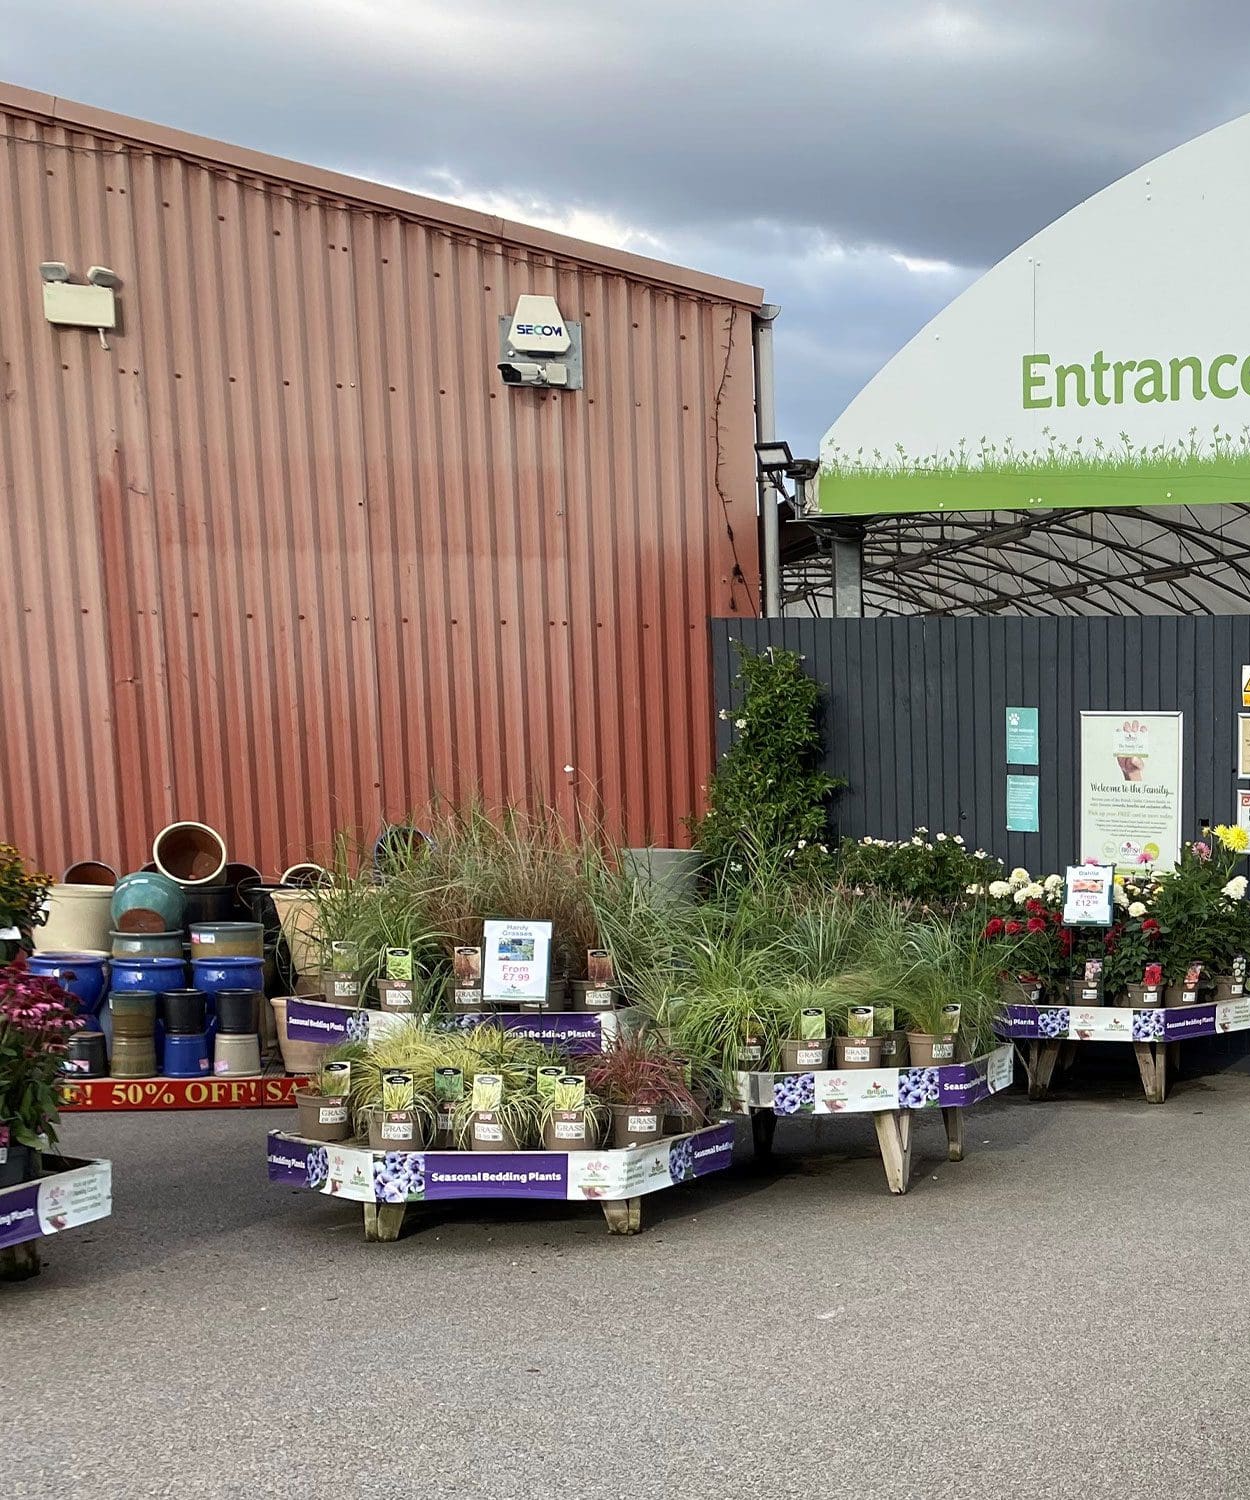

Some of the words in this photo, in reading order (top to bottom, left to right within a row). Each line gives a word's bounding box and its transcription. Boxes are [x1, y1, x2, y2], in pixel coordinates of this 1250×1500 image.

[516, 324, 562, 336] SECOM
[1090, 783, 1120, 792] Welcome
[1130, 783, 1141, 793] the
[503, 973, 529, 981] £7.99
[289, 1016, 309, 1026] Seasonal
[310, 1019, 329, 1031] Bedding
[330, 1022, 344, 1031] Plants
[1167, 1019, 1185, 1028] Seasonal
[1186, 1018, 1201, 1026] Bedding
[529, 1030, 566, 1040] Bedding
[567, 1030, 596, 1038] Plants
[112, 1082, 175, 1105] 50%
[184, 1082, 256, 1103] OFF!
[556, 1123, 584, 1132] GRASS
[694, 1145, 715, 1158] Seasonal
[273, 1155, 291, 1168] Bedding
[292, 1158, 305, 1168] Plants
[432, 1173, 481, 1181] Seasonal
[482, 1173, 527, 1183] Bedding
[529, 1173, 561, 1181] Plants
